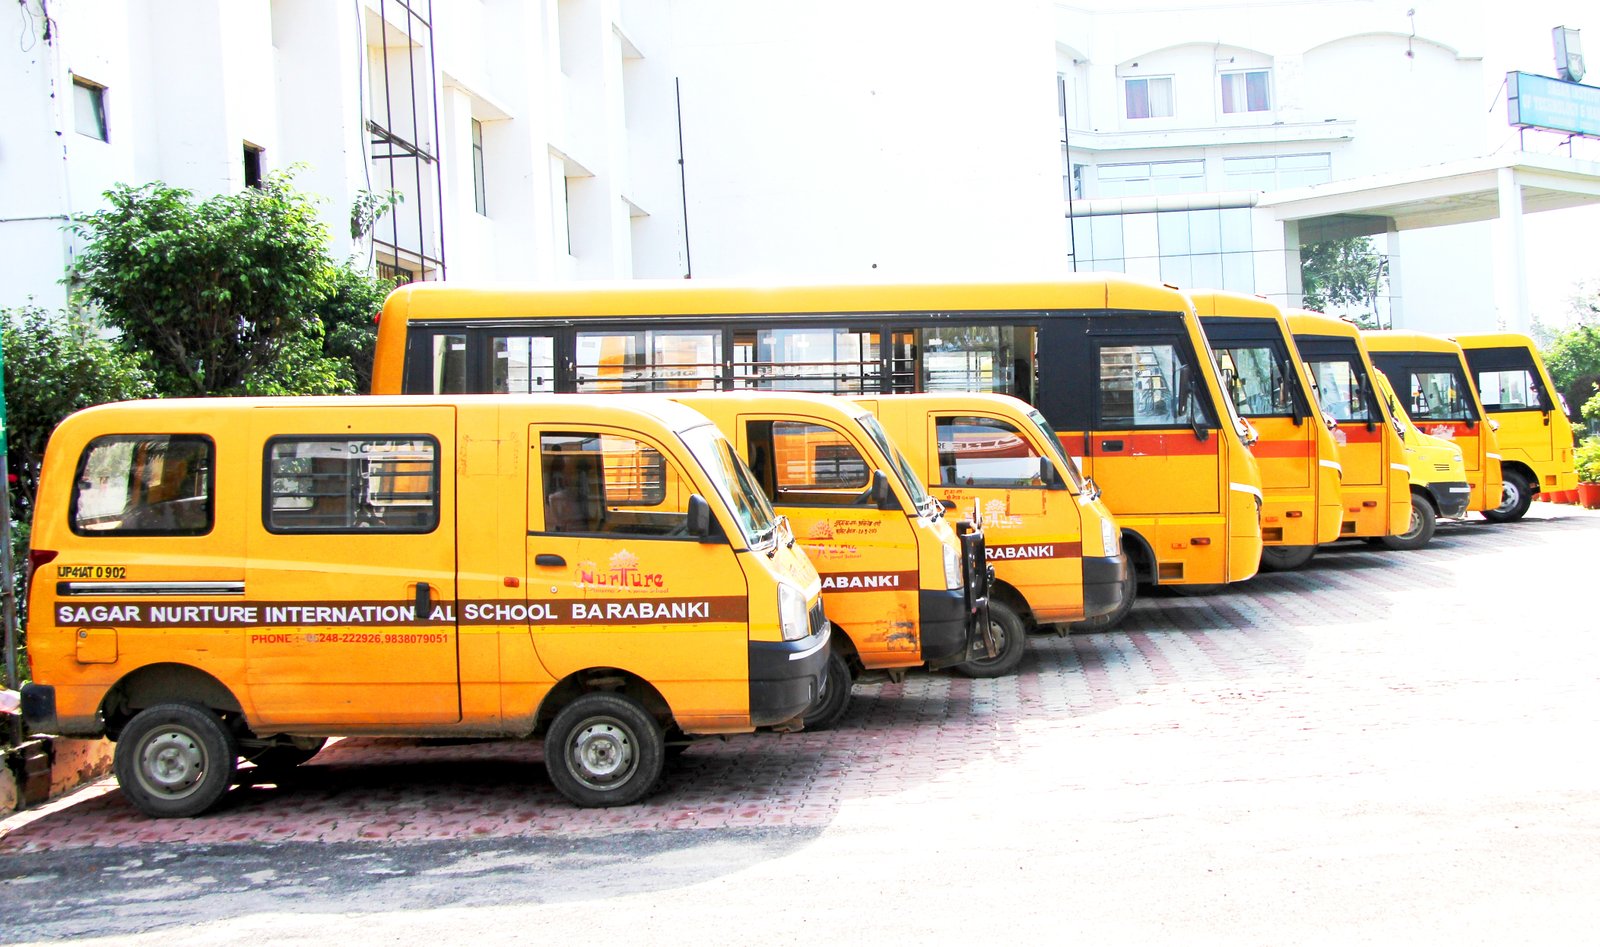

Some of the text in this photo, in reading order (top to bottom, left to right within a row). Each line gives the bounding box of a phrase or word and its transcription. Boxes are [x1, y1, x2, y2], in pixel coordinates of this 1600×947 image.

[985, 545, 1054, 559] RABANKI
[821, 575, 899, 588] ABANKI
[59, 606, 141, 623] SAGAR
[151, 605, 258, 623] NURTURE
[464, 603, 558, 621] SCHOOL
[572, 602, 710, 619] BARABANKI
[251, 634, 293, 644] PHONE
